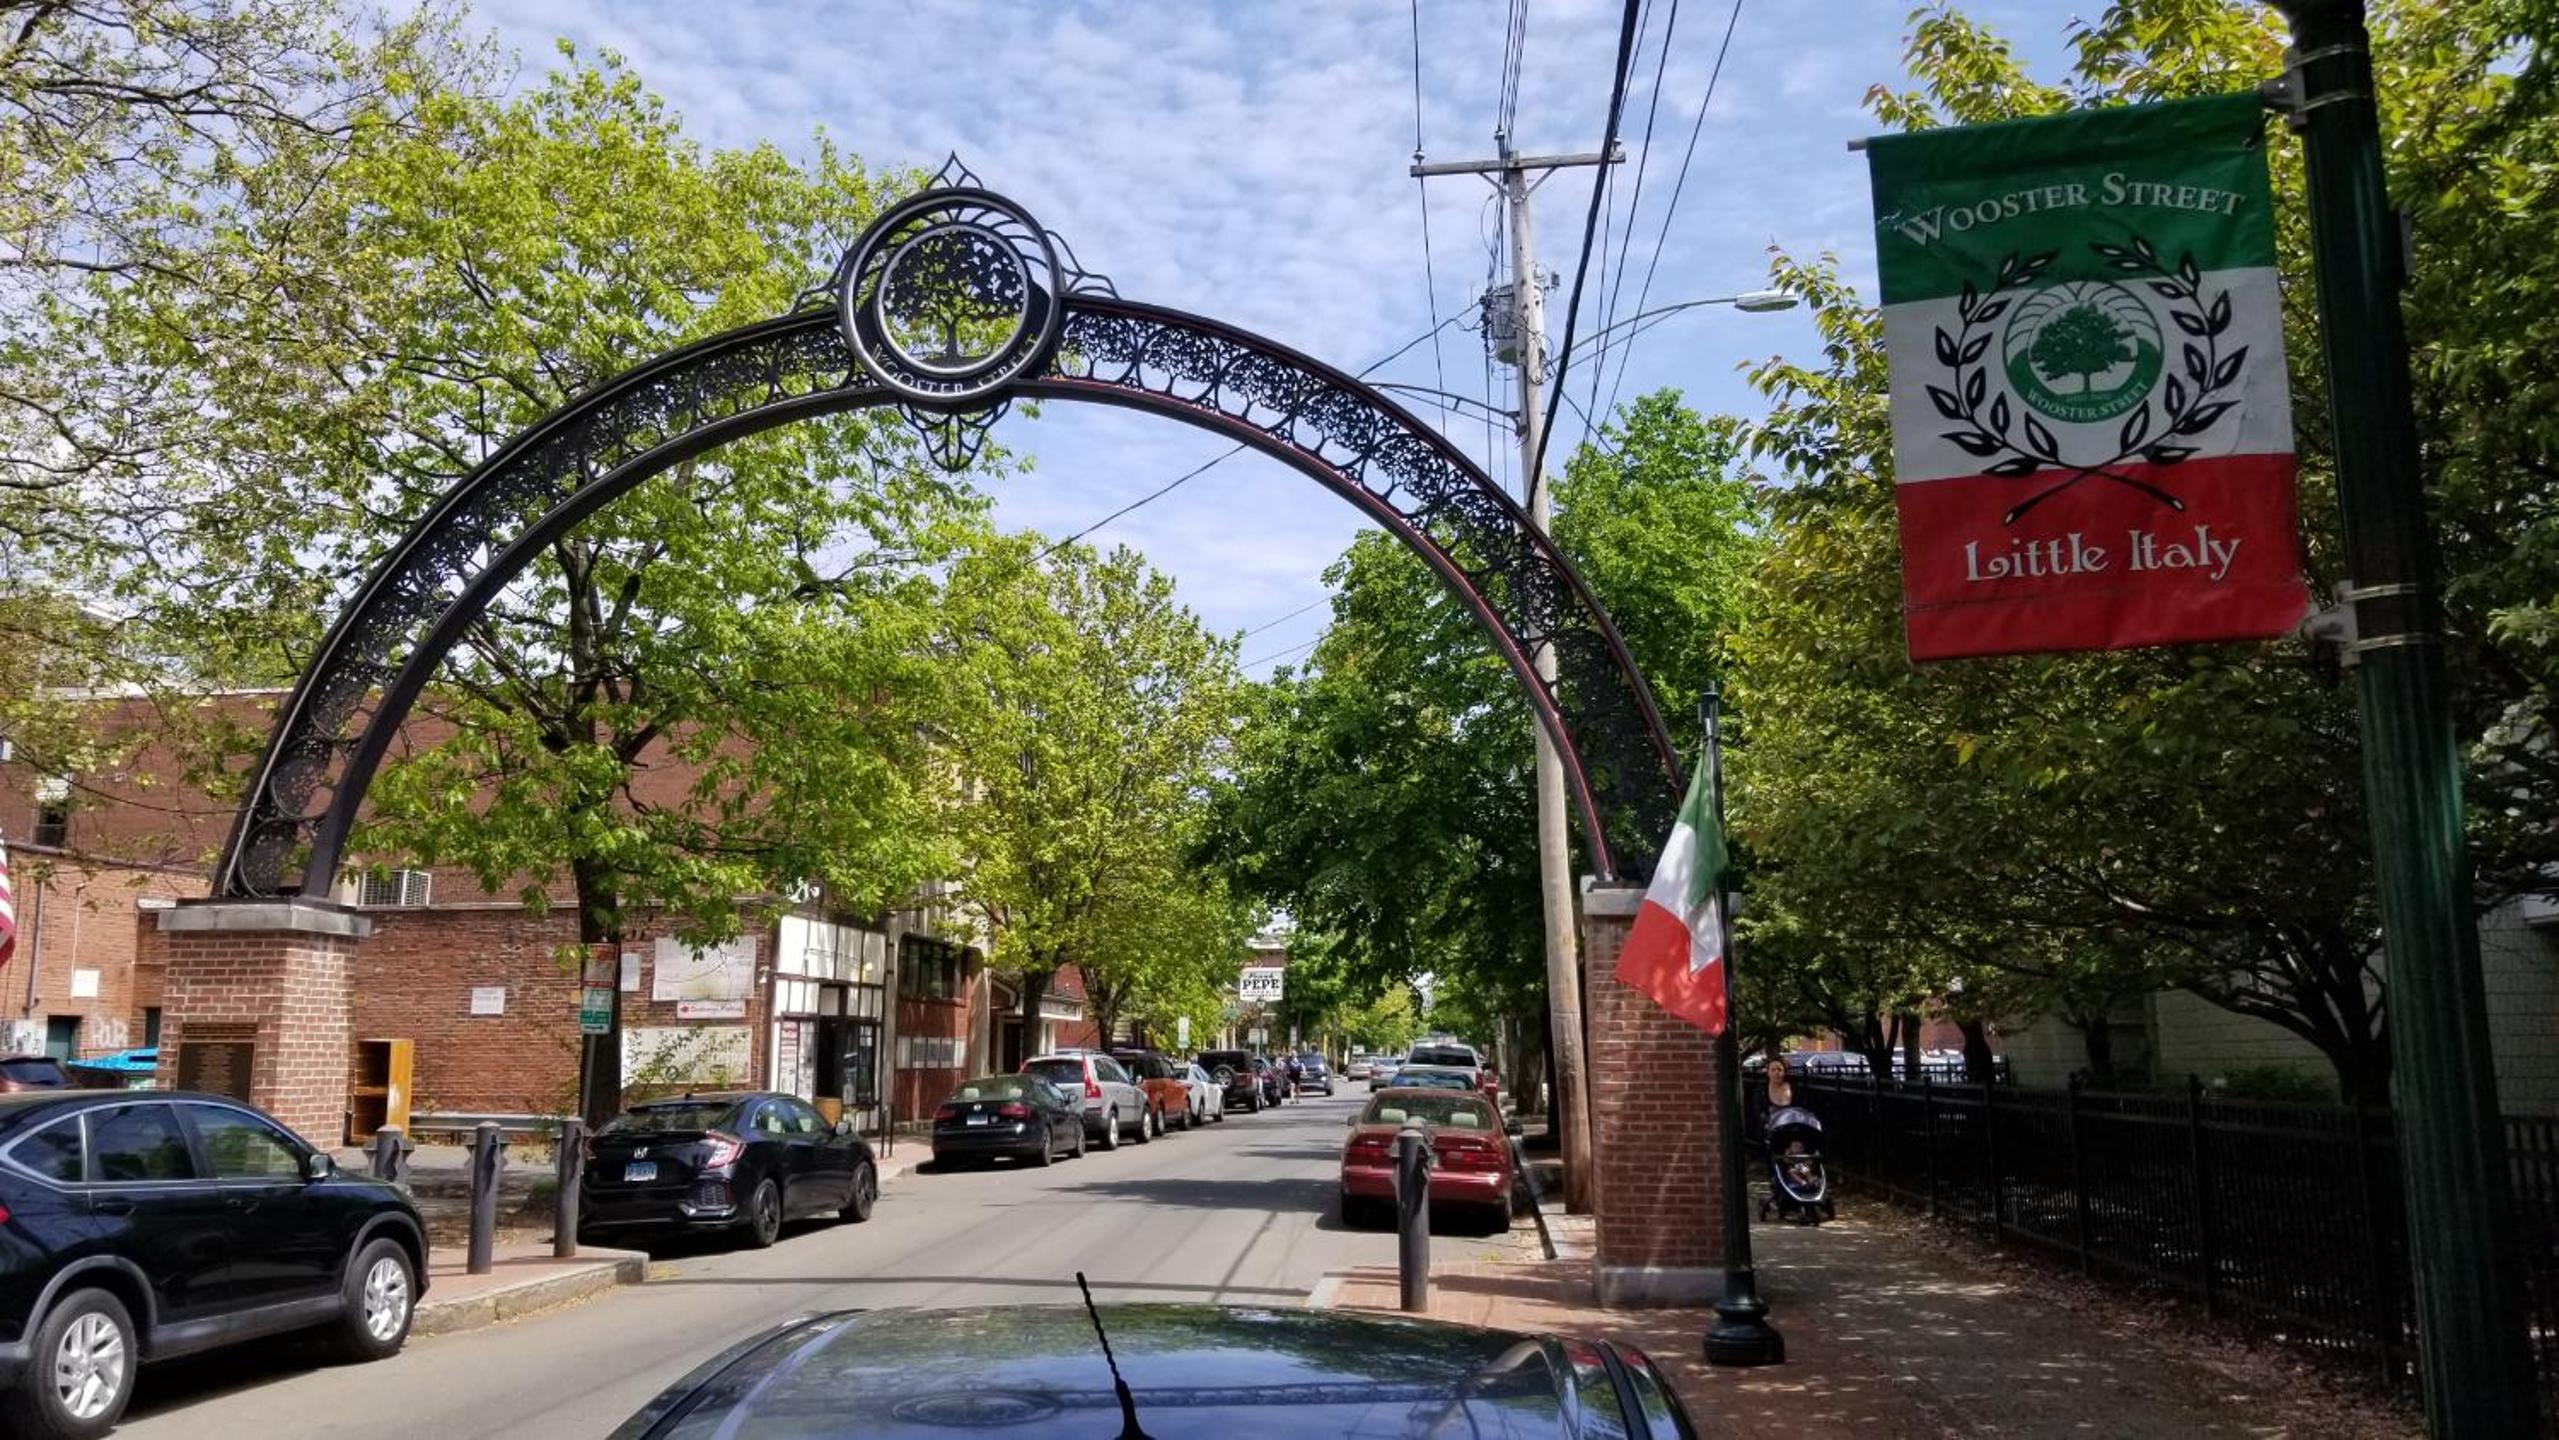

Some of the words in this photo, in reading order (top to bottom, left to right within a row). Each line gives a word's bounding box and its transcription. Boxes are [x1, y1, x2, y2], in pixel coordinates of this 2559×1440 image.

[1899, 183, 2091, 247] WOOSTER
[2100, 171, 2245, 217] STREET
[872, 343, 965, 394] WOOSTER
[2027, 388, 2098, 419] WOOSTER
[2101, 381, 2149, 415] STREET
[1964, 532, 2110, 582] Little
[2128, 524, 2242, 581] Italy
[1242, 978, 1280, 991] PEPE
